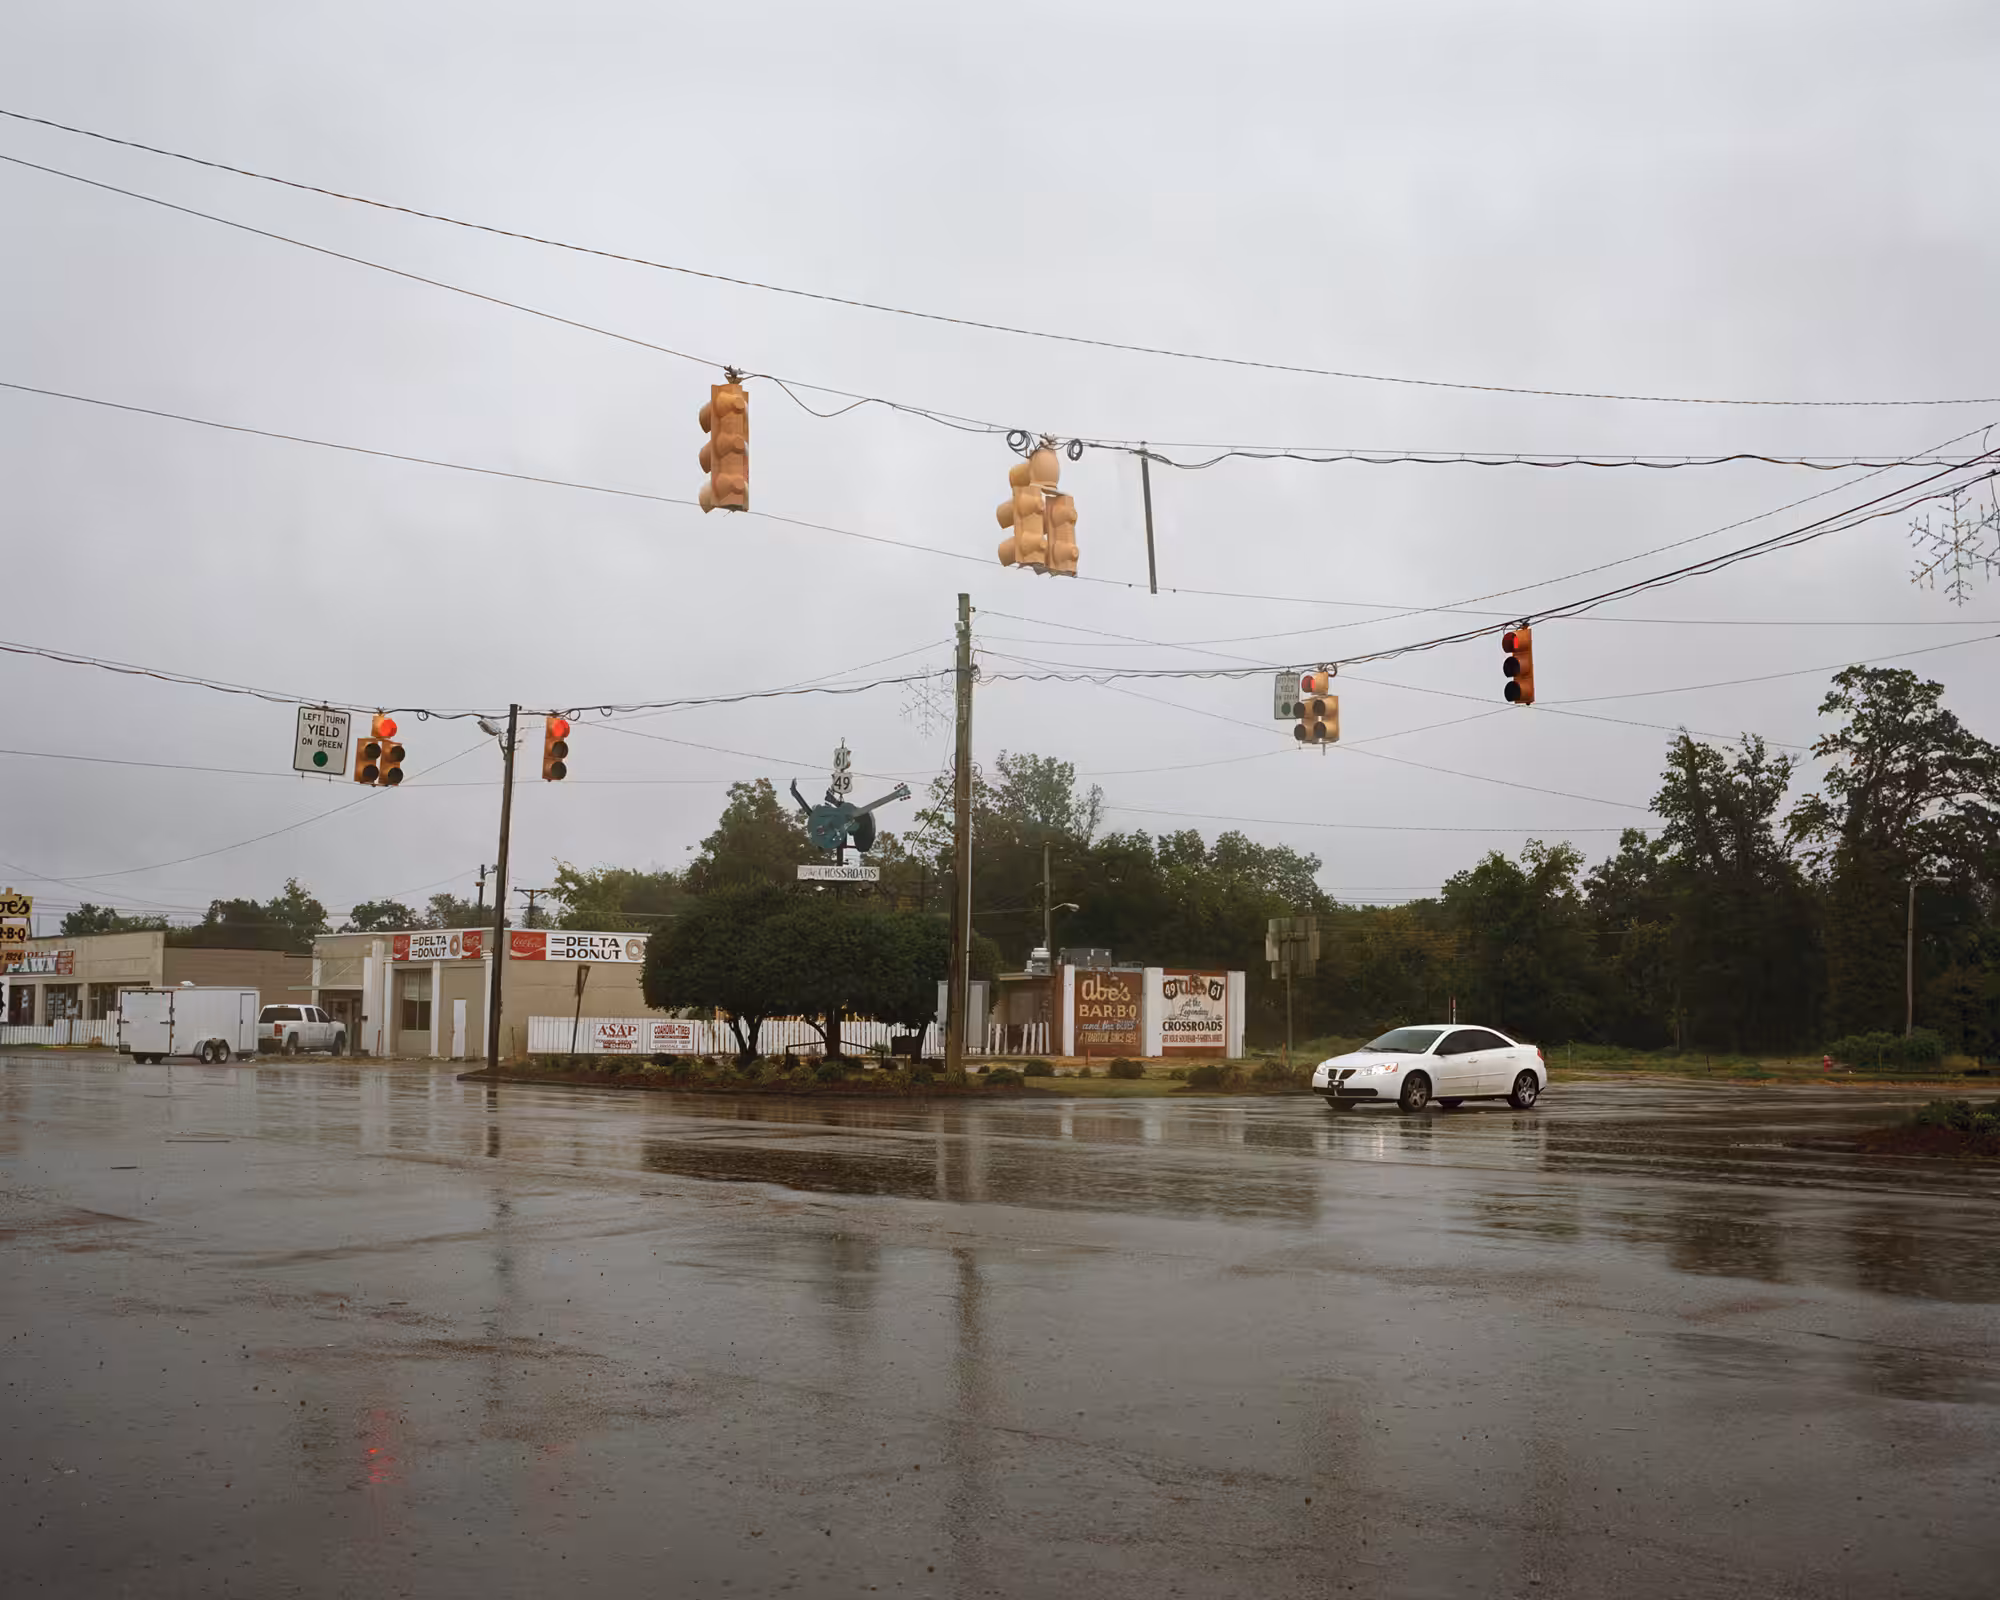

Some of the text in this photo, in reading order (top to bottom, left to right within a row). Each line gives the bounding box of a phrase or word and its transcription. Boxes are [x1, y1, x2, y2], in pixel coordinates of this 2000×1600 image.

[303, 712, 346, 725] LEFT TURN
[308, 724, 340, 738] YIELD
[302, 737, 343, 749] ON GREEN
[835, 751, 846, 767] 61
[834, 776, 850, 790] 49
[0, 896, 30, 915] e's
[418, 936, 447, 946] DELTA
[566, 936, 620, 948] DELTA
[417, 947, 447, 958] DONUT
[566, 948, 622, 959] DONUT
[1164, 982, 1176, 997] 49
[1210, 983, 1221, 999] 61
[1162, 1021, 1223, 1032] CROSSROADS
